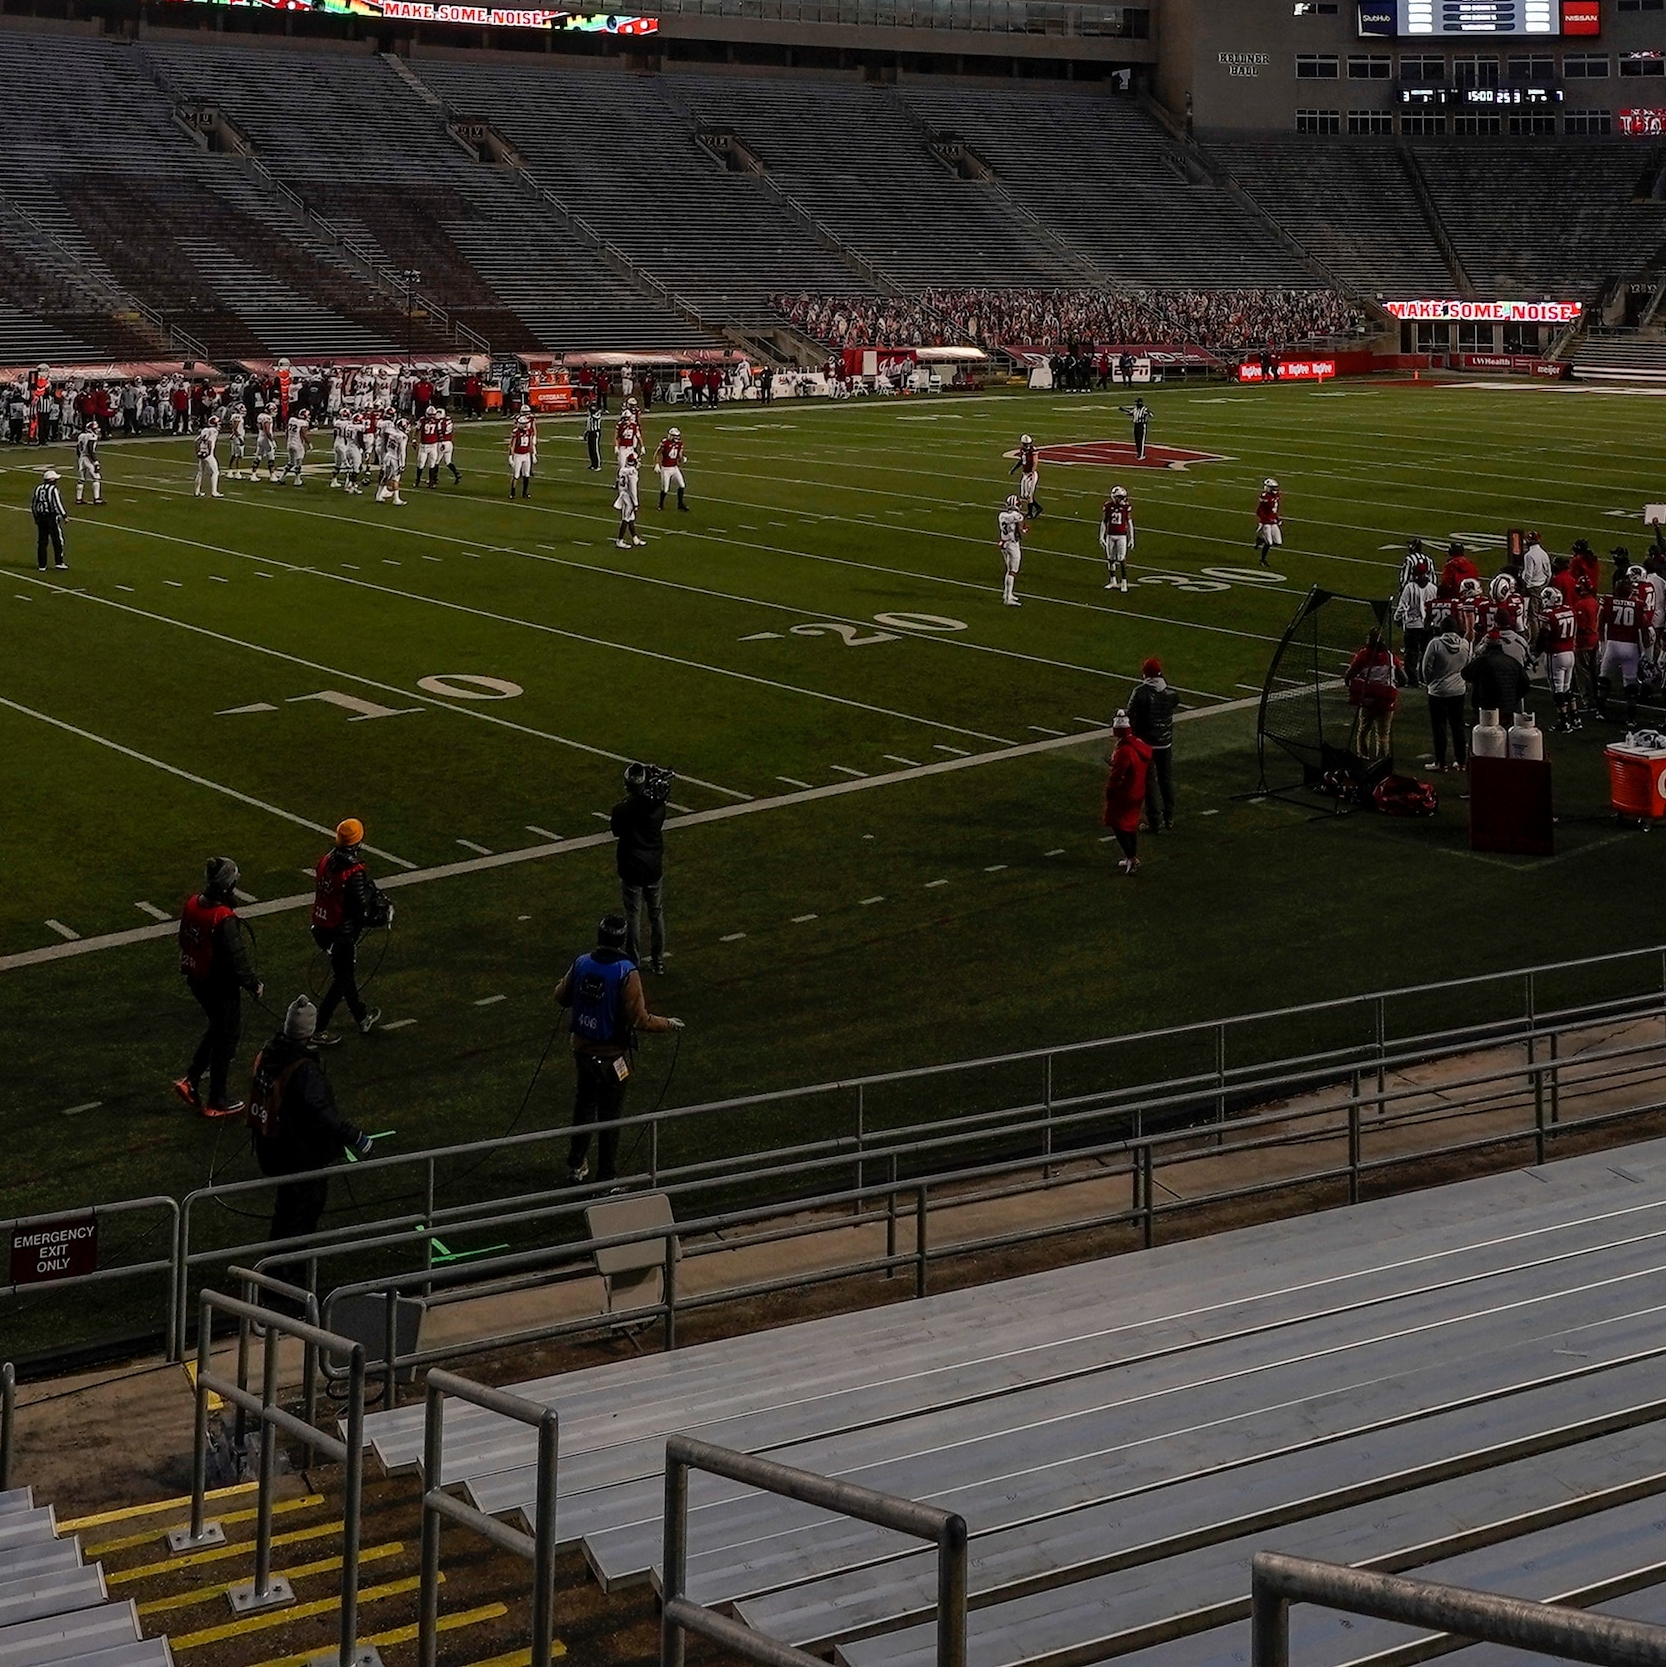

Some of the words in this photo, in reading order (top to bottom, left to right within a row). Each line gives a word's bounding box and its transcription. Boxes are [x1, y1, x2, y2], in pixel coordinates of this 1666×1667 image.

[383, 1, 433, 19] MAKE
[438, 5, 487, 23] SOME
[492, 9, 543, 26] NOISE
[1564, 14, 1598, 22] NISSAN
[1468, 90, 1494, 102] 15:00
[1496, 92, 1511, 104] 25
[1388, 301, 1441, 321] MAKE
[1444, 301, 1504, 322] SOME
[1511, 303, 1573, 323] NOISE
[1137, 566, 1288, 593] 30
[1612, 605, 1635, 626] 70
[789, 611, 968, 647] 20
[1558, 617, 1575, 639] 77
[285, 672, 524, 722] 10
[13, 1225, 95, 1250] EMERGENCY
[38, 1246, 68, 1260] EXIT
[36, 1257, 72, 1273] ONLY
